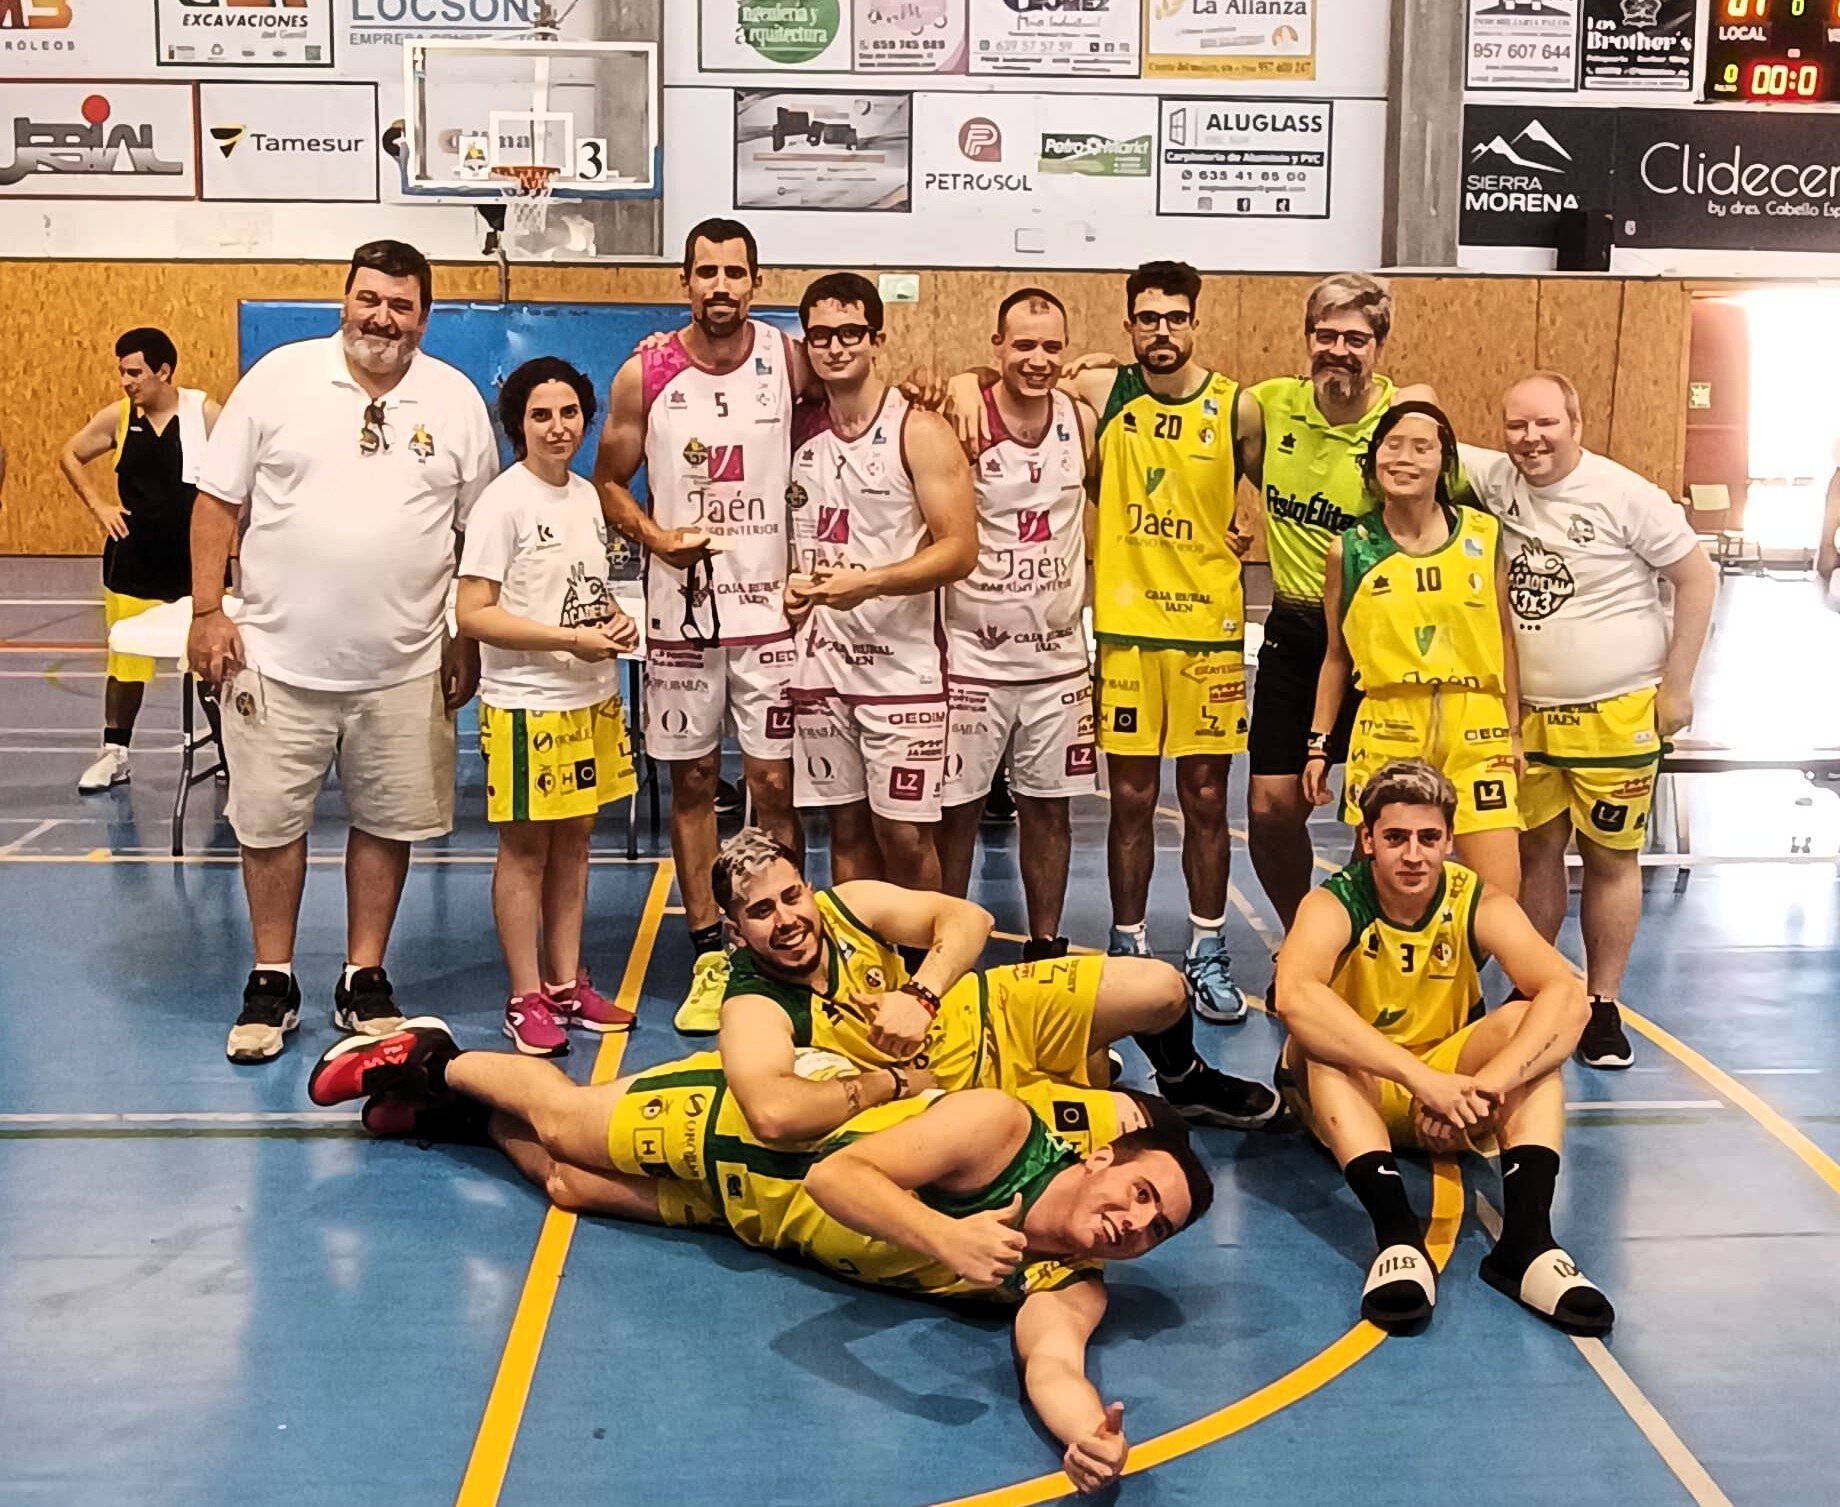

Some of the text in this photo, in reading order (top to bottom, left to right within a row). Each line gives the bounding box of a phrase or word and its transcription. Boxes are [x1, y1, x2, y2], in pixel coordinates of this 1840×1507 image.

[1193, 0, 1307, 15] La Alianza
[183, 14, 308, 27] EXCAVACIONES
[1587, 31, 1692, 51] Brother's
[1719, 26, 1767, 41] LOCAL
[1507, 44, 1537, 59] 607
[1541, 44, 1571, 60] 644
[1206, 114, 1323, 133] ALUGLASS
[251, 133, 364, 152] Tamesur
[579, 141, 602, 179] 3
[925, 173, 1033, 192] PETROSOL
[1467, 175, 1543, 191] SIERRA
[1465, 193, 1579, 213] MORENA
[1708, 200, 1726, 216] by
[714, 392, 729, 418] 5
[1153, 412, 1183, 441] 20
[687, 490, 765, 525] Jaén
[1126, 508, 1193, 541] Jaén
[997, 546, 1068, 581] Jaén
[1416, 566, 1442, 593] 10
[1071, 749, 1092, 766] LZ
[896, 773, 919, 791] LZ
[1400, 943, 1415, 973] 3
